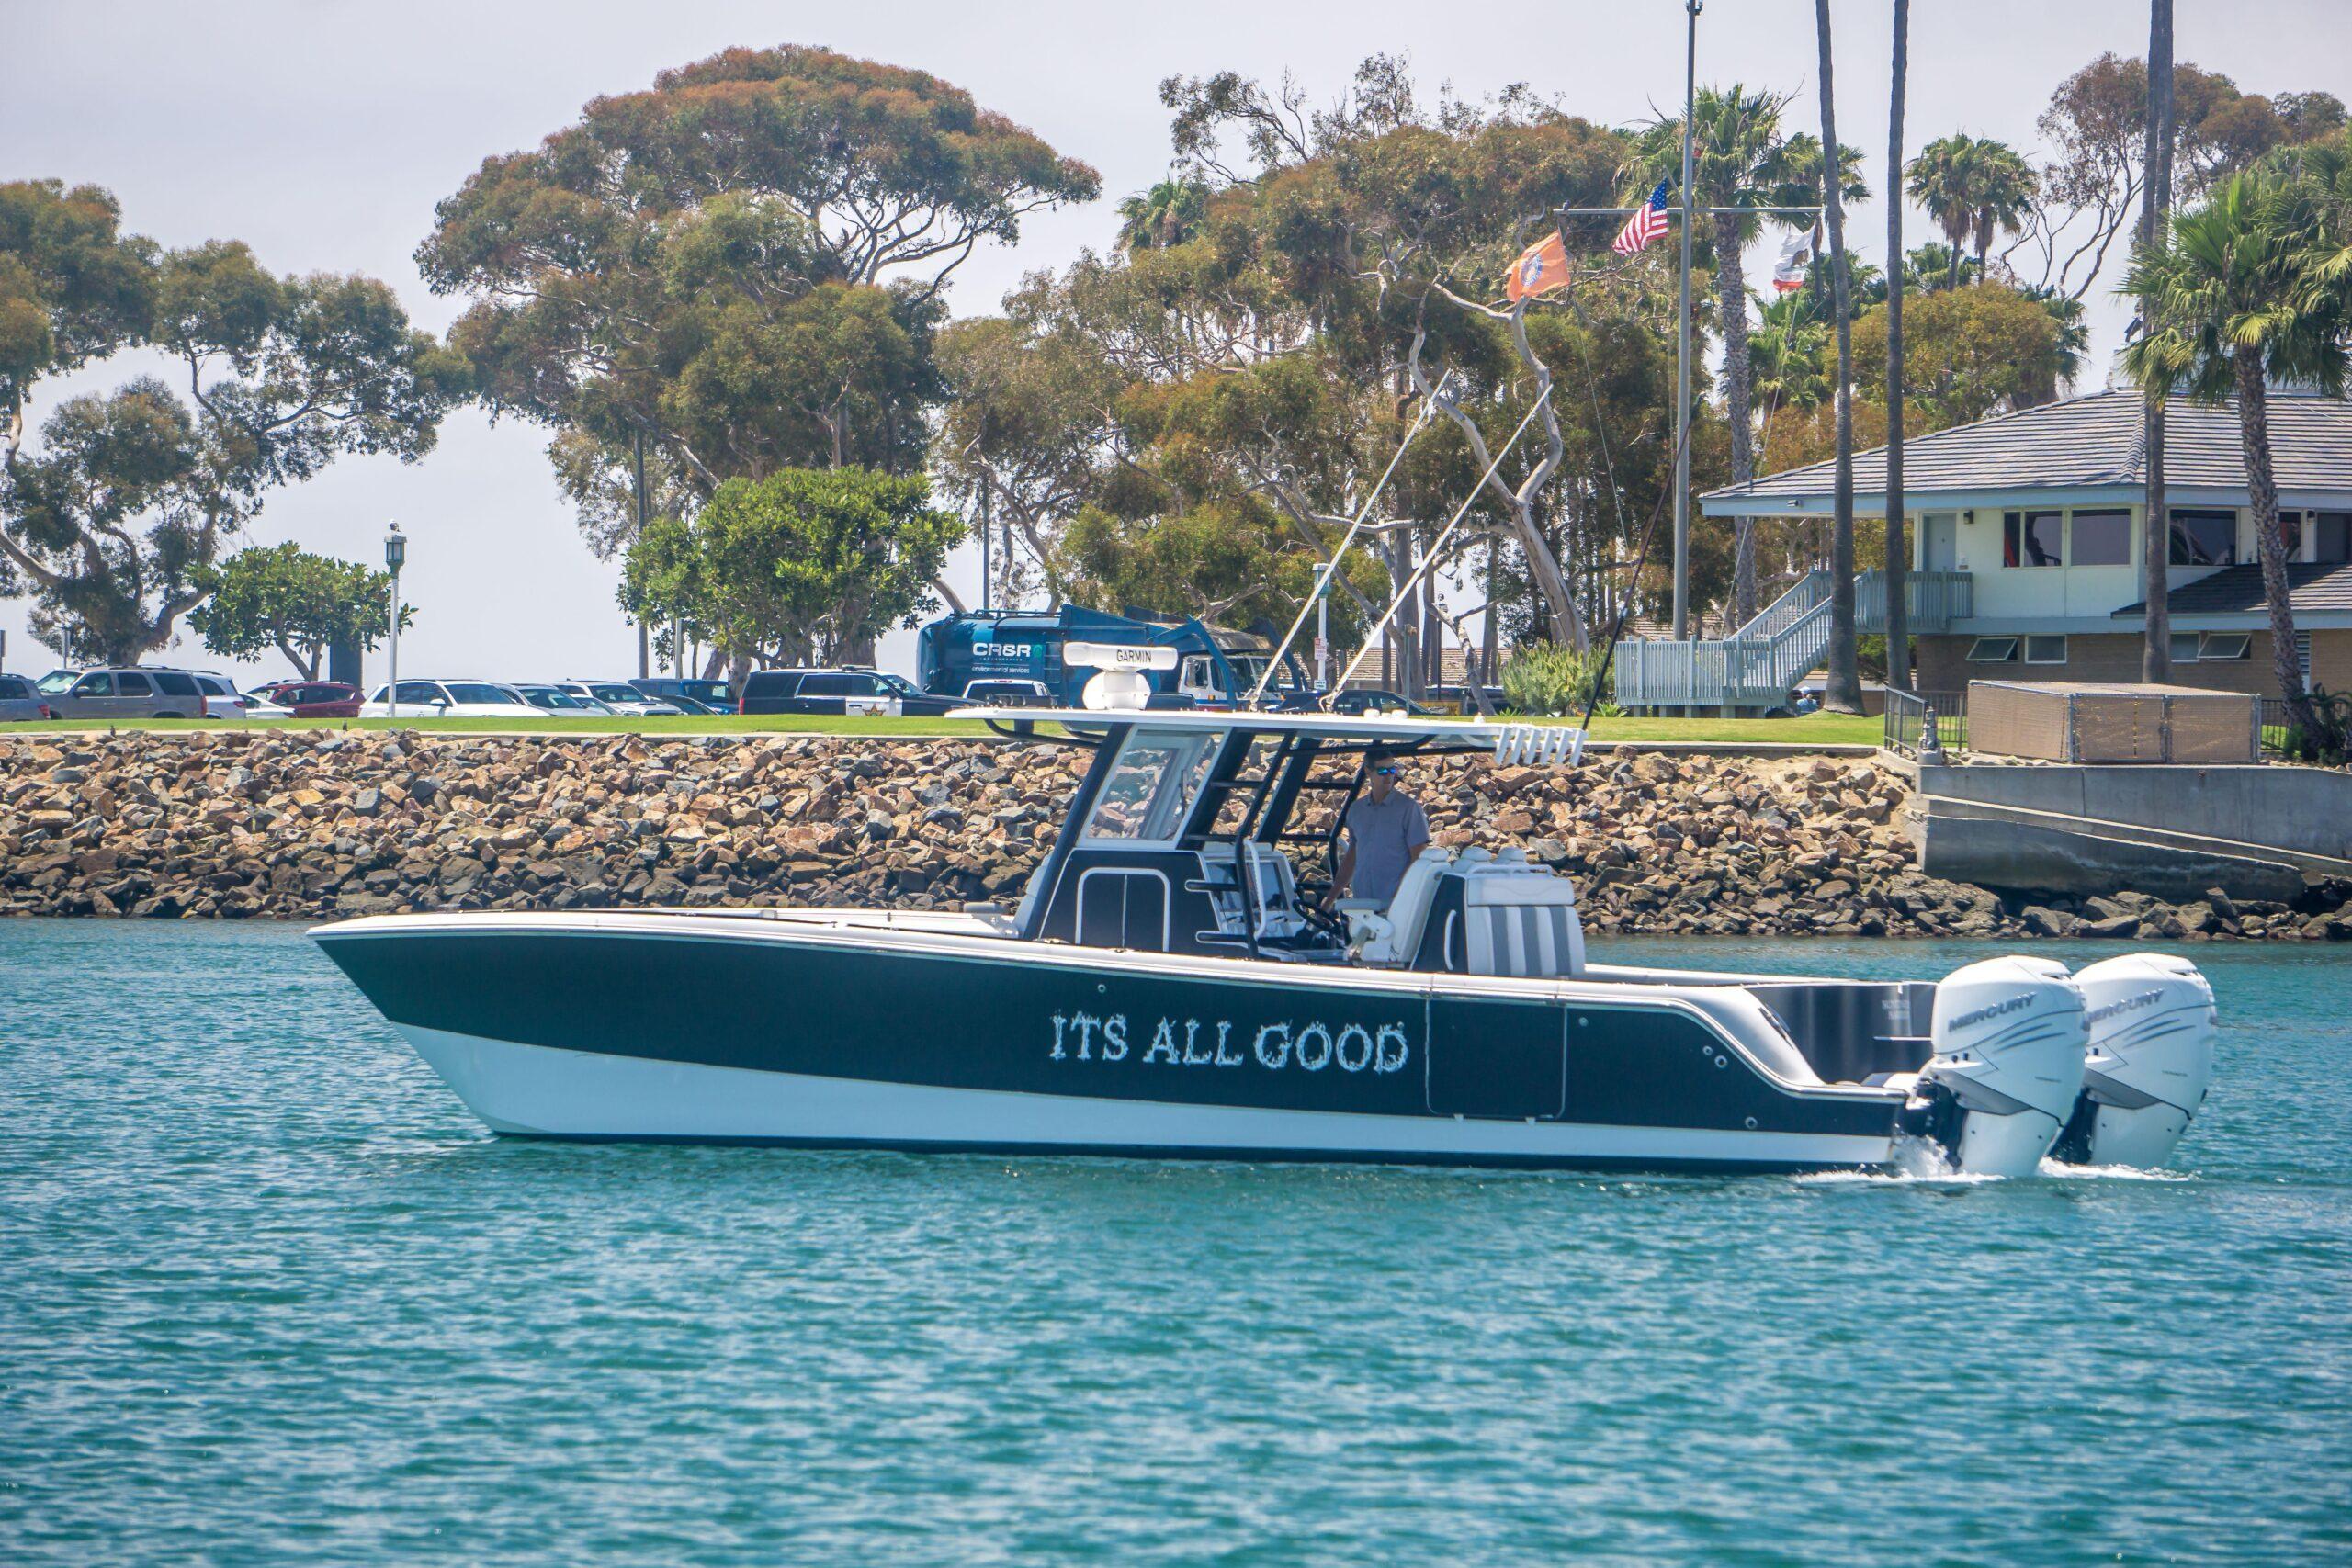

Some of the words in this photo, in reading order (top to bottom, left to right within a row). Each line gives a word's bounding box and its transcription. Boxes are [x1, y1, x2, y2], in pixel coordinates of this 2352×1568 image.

[973, 642, 1031, 657] CR&R
[1116, 649, 1152, 663] GARMIN
[1948, 992, 2037, 1032] MERCURY
[2086, 988, 2165, 1023] ERCURY
[1049, 1010, 1129, 1062] ITS
[1141, 1016, 1244, 1067] ALL
[1253, 1019, 1409, 1075] GOOD
